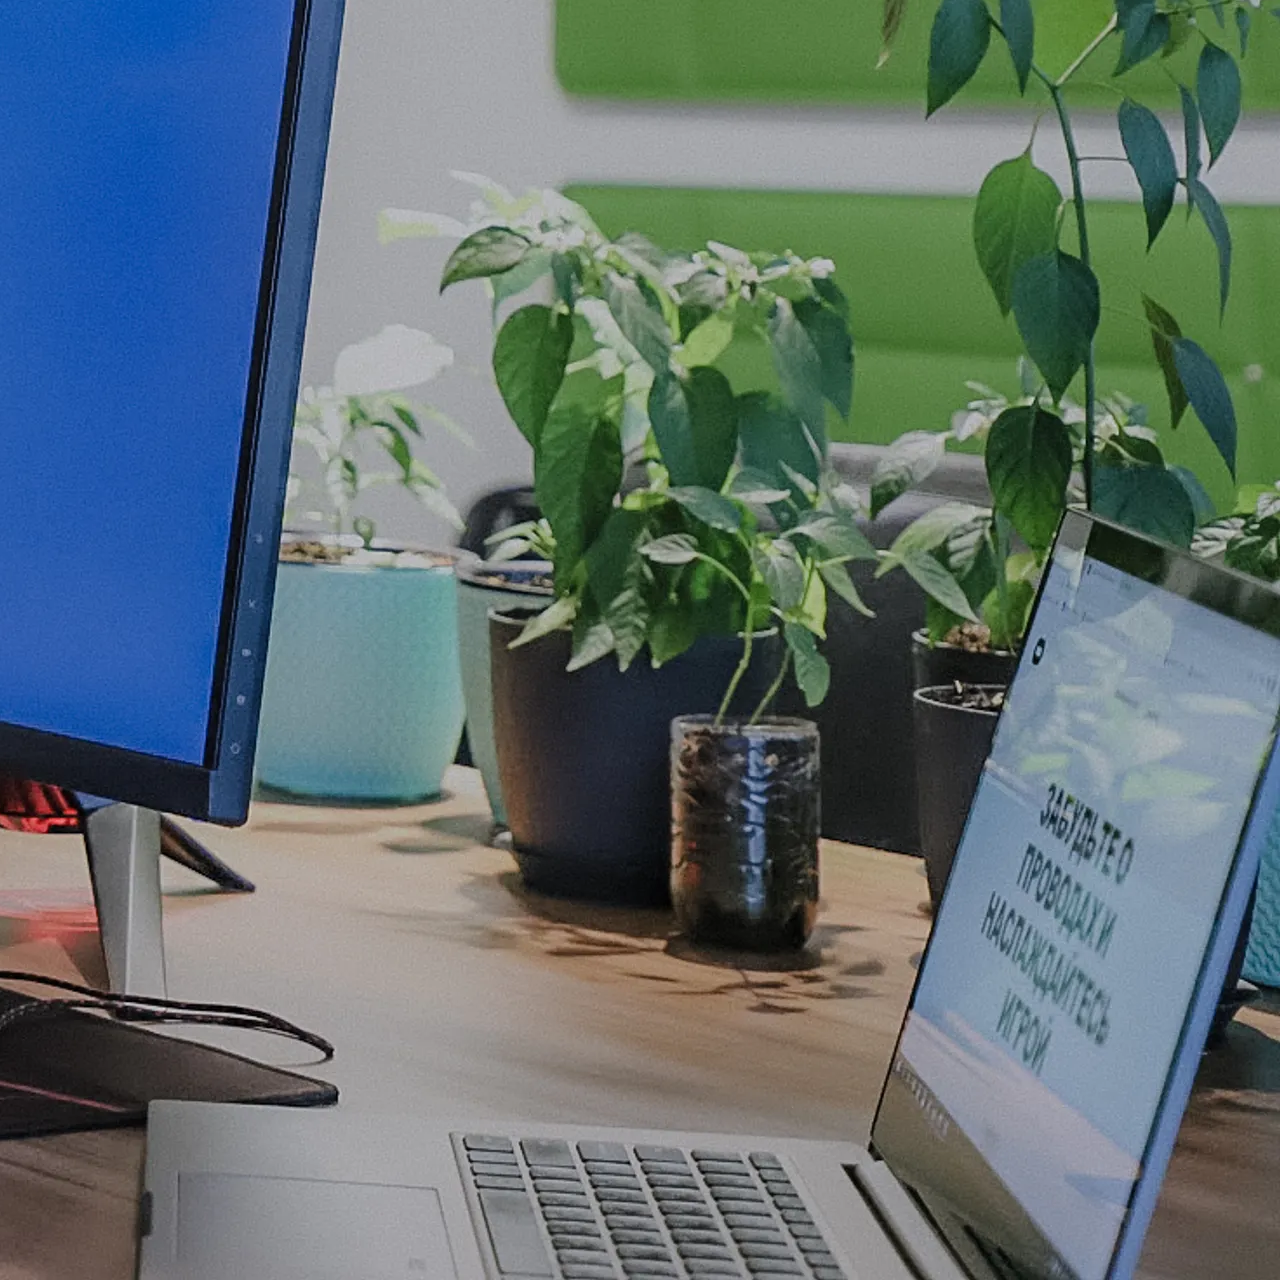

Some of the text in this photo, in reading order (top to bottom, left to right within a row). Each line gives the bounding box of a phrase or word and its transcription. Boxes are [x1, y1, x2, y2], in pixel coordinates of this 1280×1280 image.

[1041, 783, 1121, 877] ЗАБУДЬТЕ
[1016, 841, 1118, 960] ПРОВОДАХ И
[981, 890, 1111, 1045] НАСЛАЖДАЙТЕСЬ
[996, 987, 1052, 1076] ИГРОЙ
